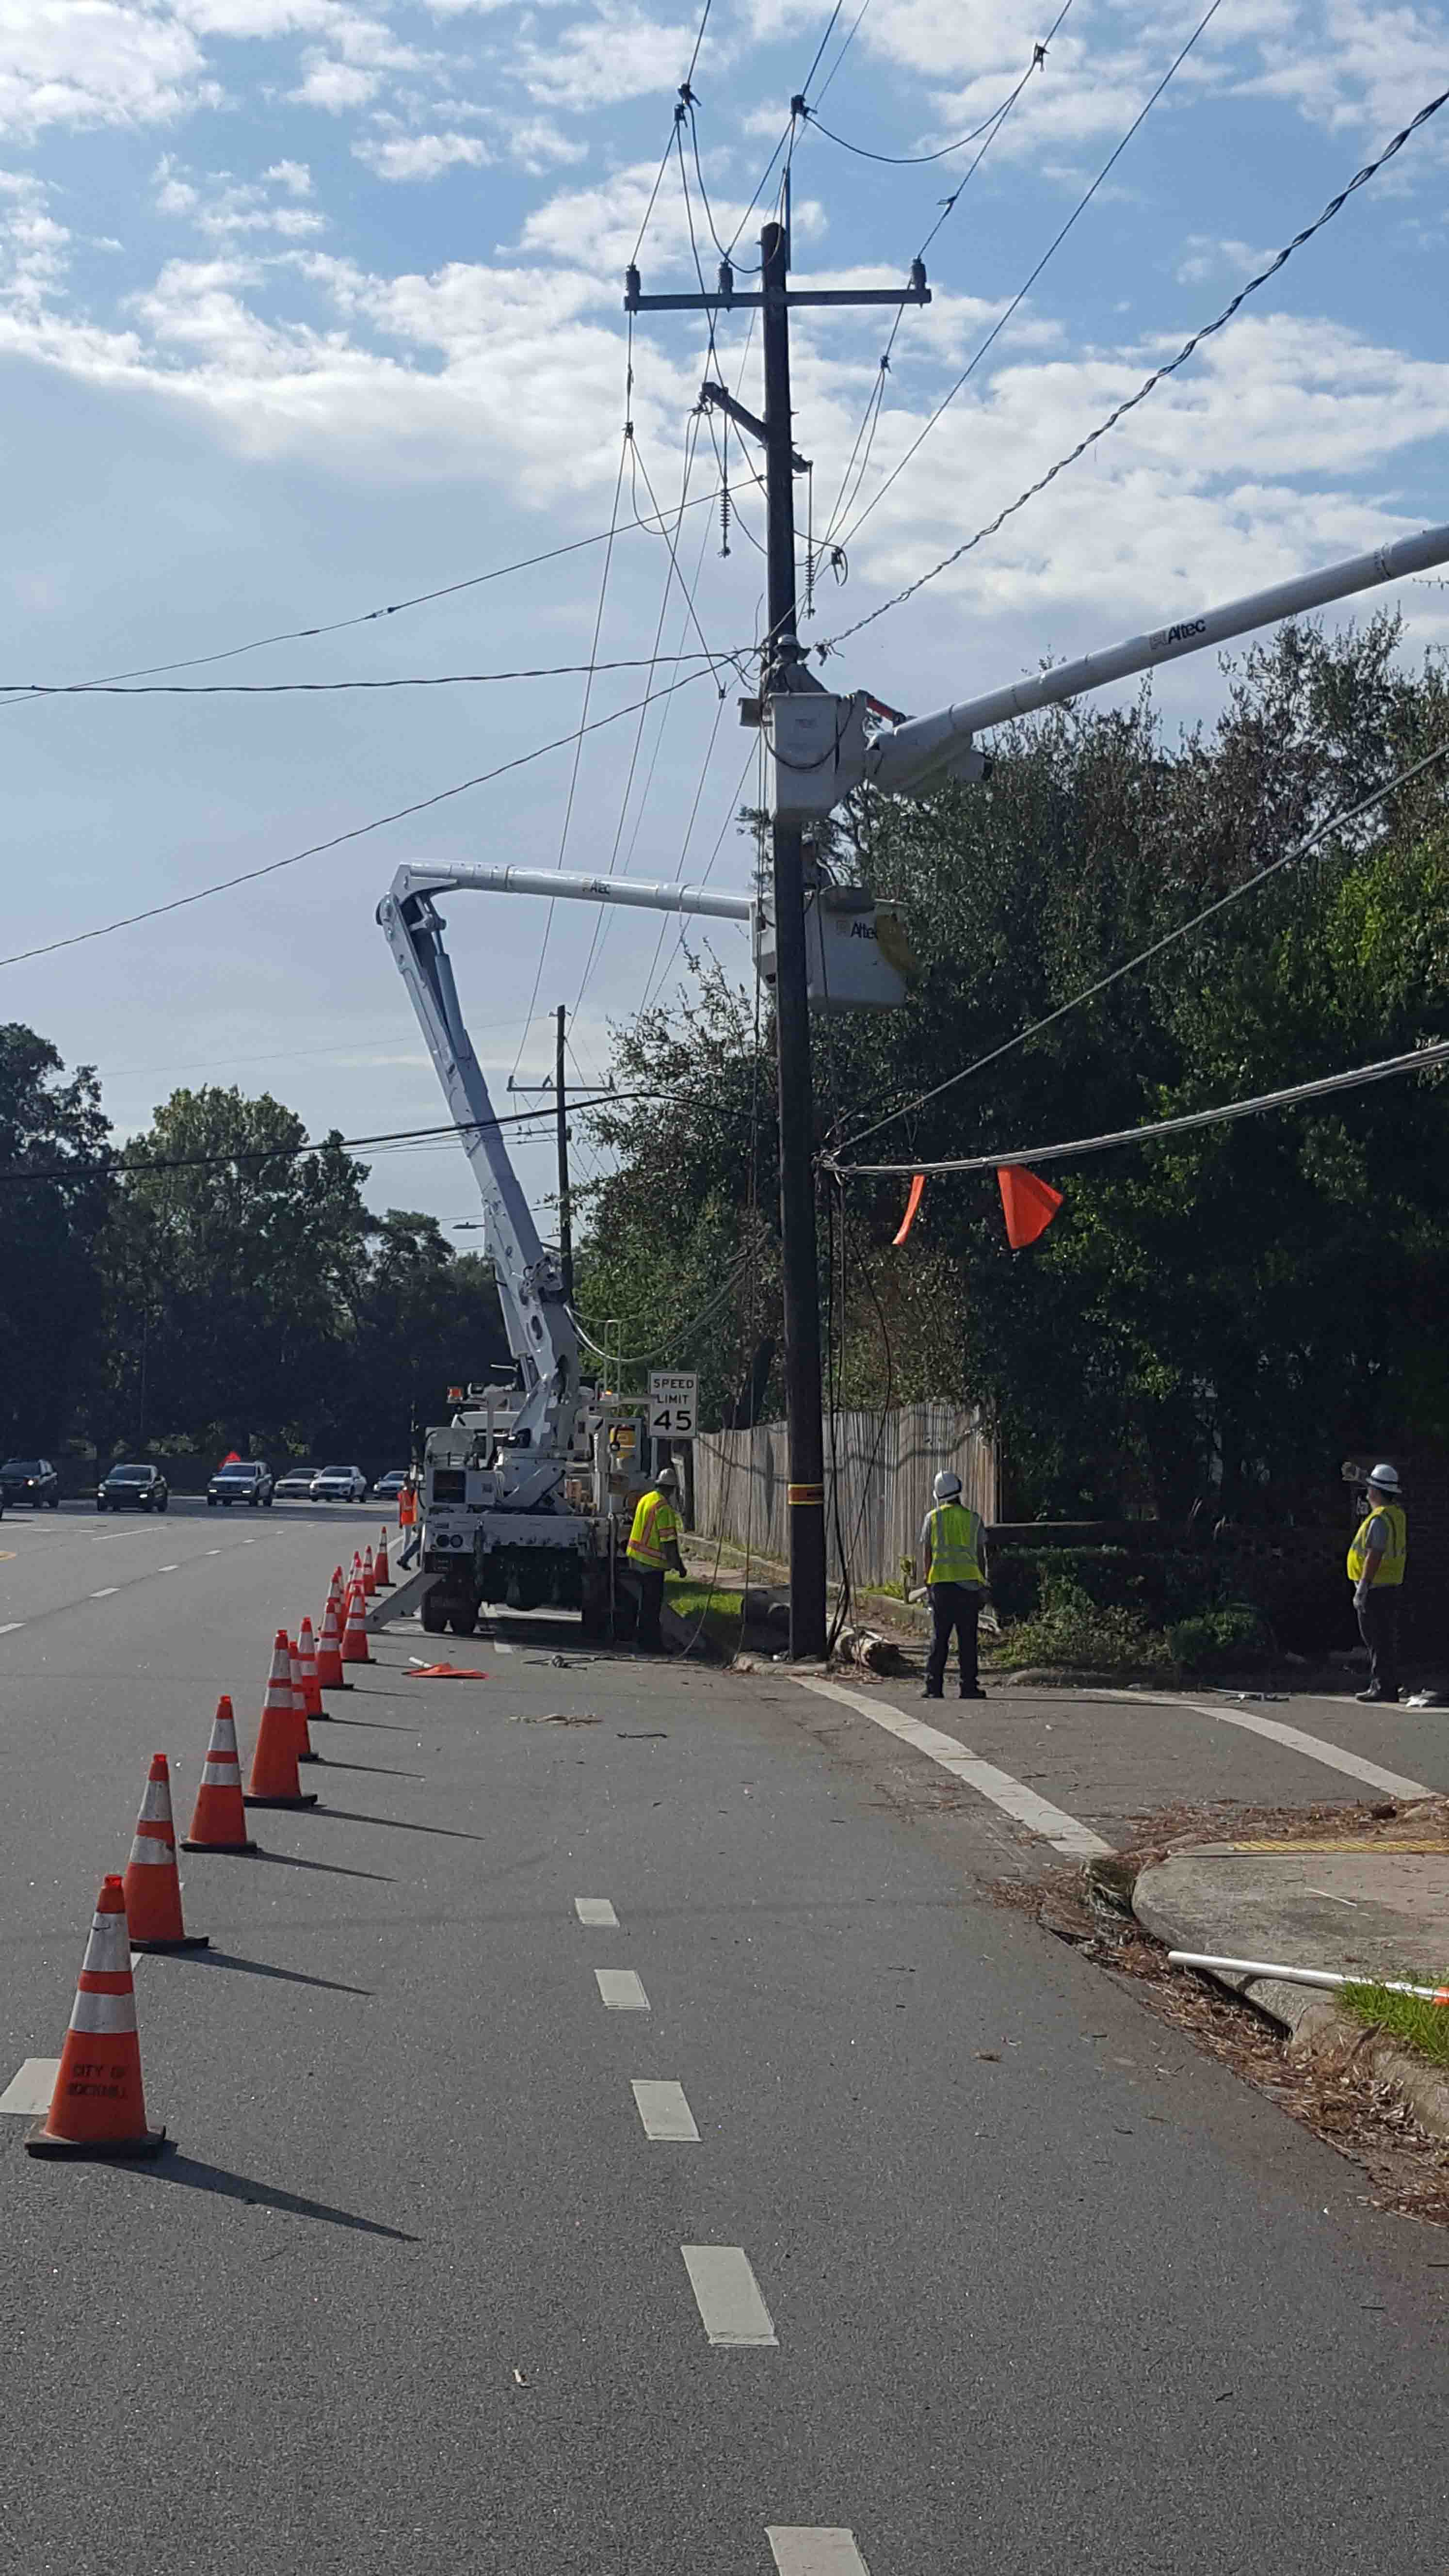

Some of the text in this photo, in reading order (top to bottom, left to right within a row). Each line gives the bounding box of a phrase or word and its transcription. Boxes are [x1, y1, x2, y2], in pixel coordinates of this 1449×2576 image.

[1168, 619, 1206, 644] Altec
[850, 921, 879, 939] Alte
[654, 1379, 694, 1388] SPEED
[657, 1394, 689, 1404] LIMIT
[653, 1409, 692, 1431] 45
[73, 2063, 102, 2077] CITY
